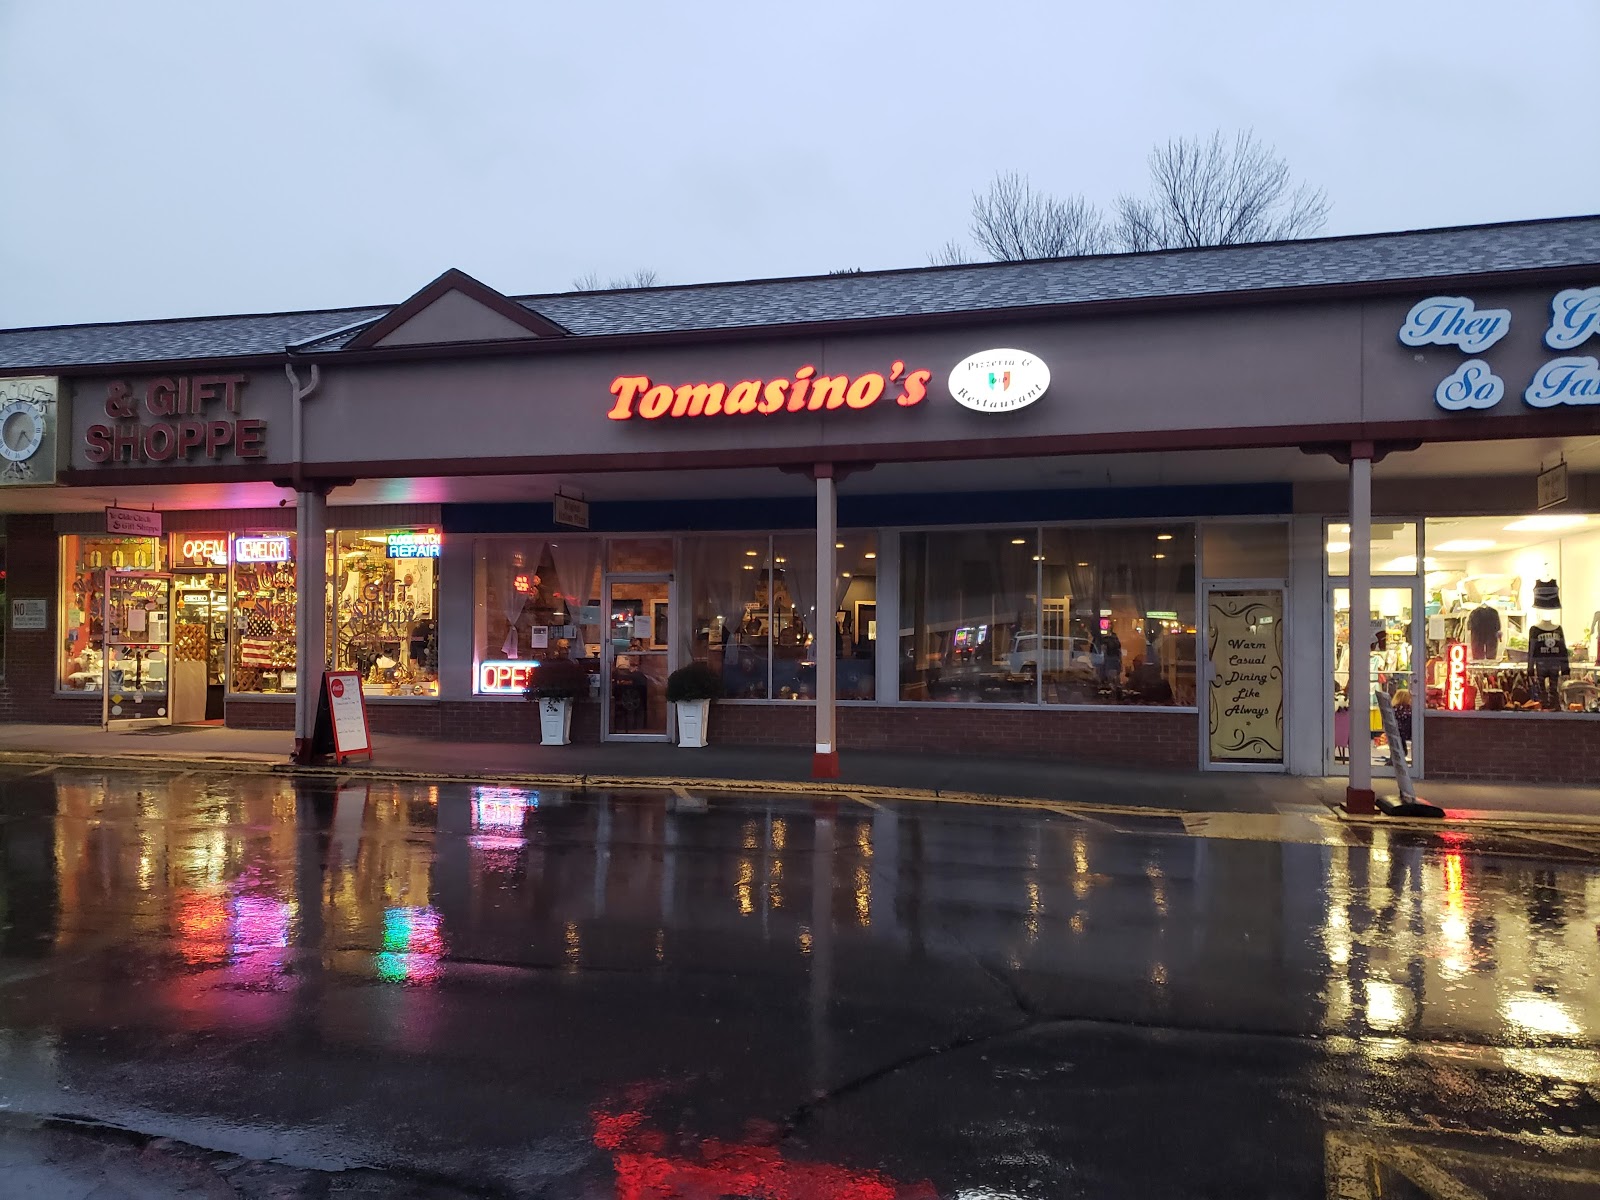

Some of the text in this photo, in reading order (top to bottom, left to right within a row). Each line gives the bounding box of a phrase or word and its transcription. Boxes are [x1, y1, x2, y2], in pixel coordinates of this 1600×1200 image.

[1408, 294, 1600, 346] They G
[968, 360, 1015, 371] Pizzeria
[606, 360, 932, 420] Tomasino's
[1444, 367, 1495, 402] So
[104, 374, 246, 418] & GIFT
[958, 383, 1042, 408] Restaurant
[85, 419, 266, 463] SHOPPE
[183, 539, 226, 558] OPEN
[238, 540, 285, 559] JEWELRY
[389, 545, 440, 557] REPAIR
[14, 603, 25, 616] NO
[1228, 639, 1266, 649] Warm
[1228, 655, 1266, 665] Casual
[1225, 671, 1267, 685] Dining
[1448, 645, 1465, 710] OPEN
[1232, 688, 1260, 702] Like
[1224, 704, 1269, 719] Always
